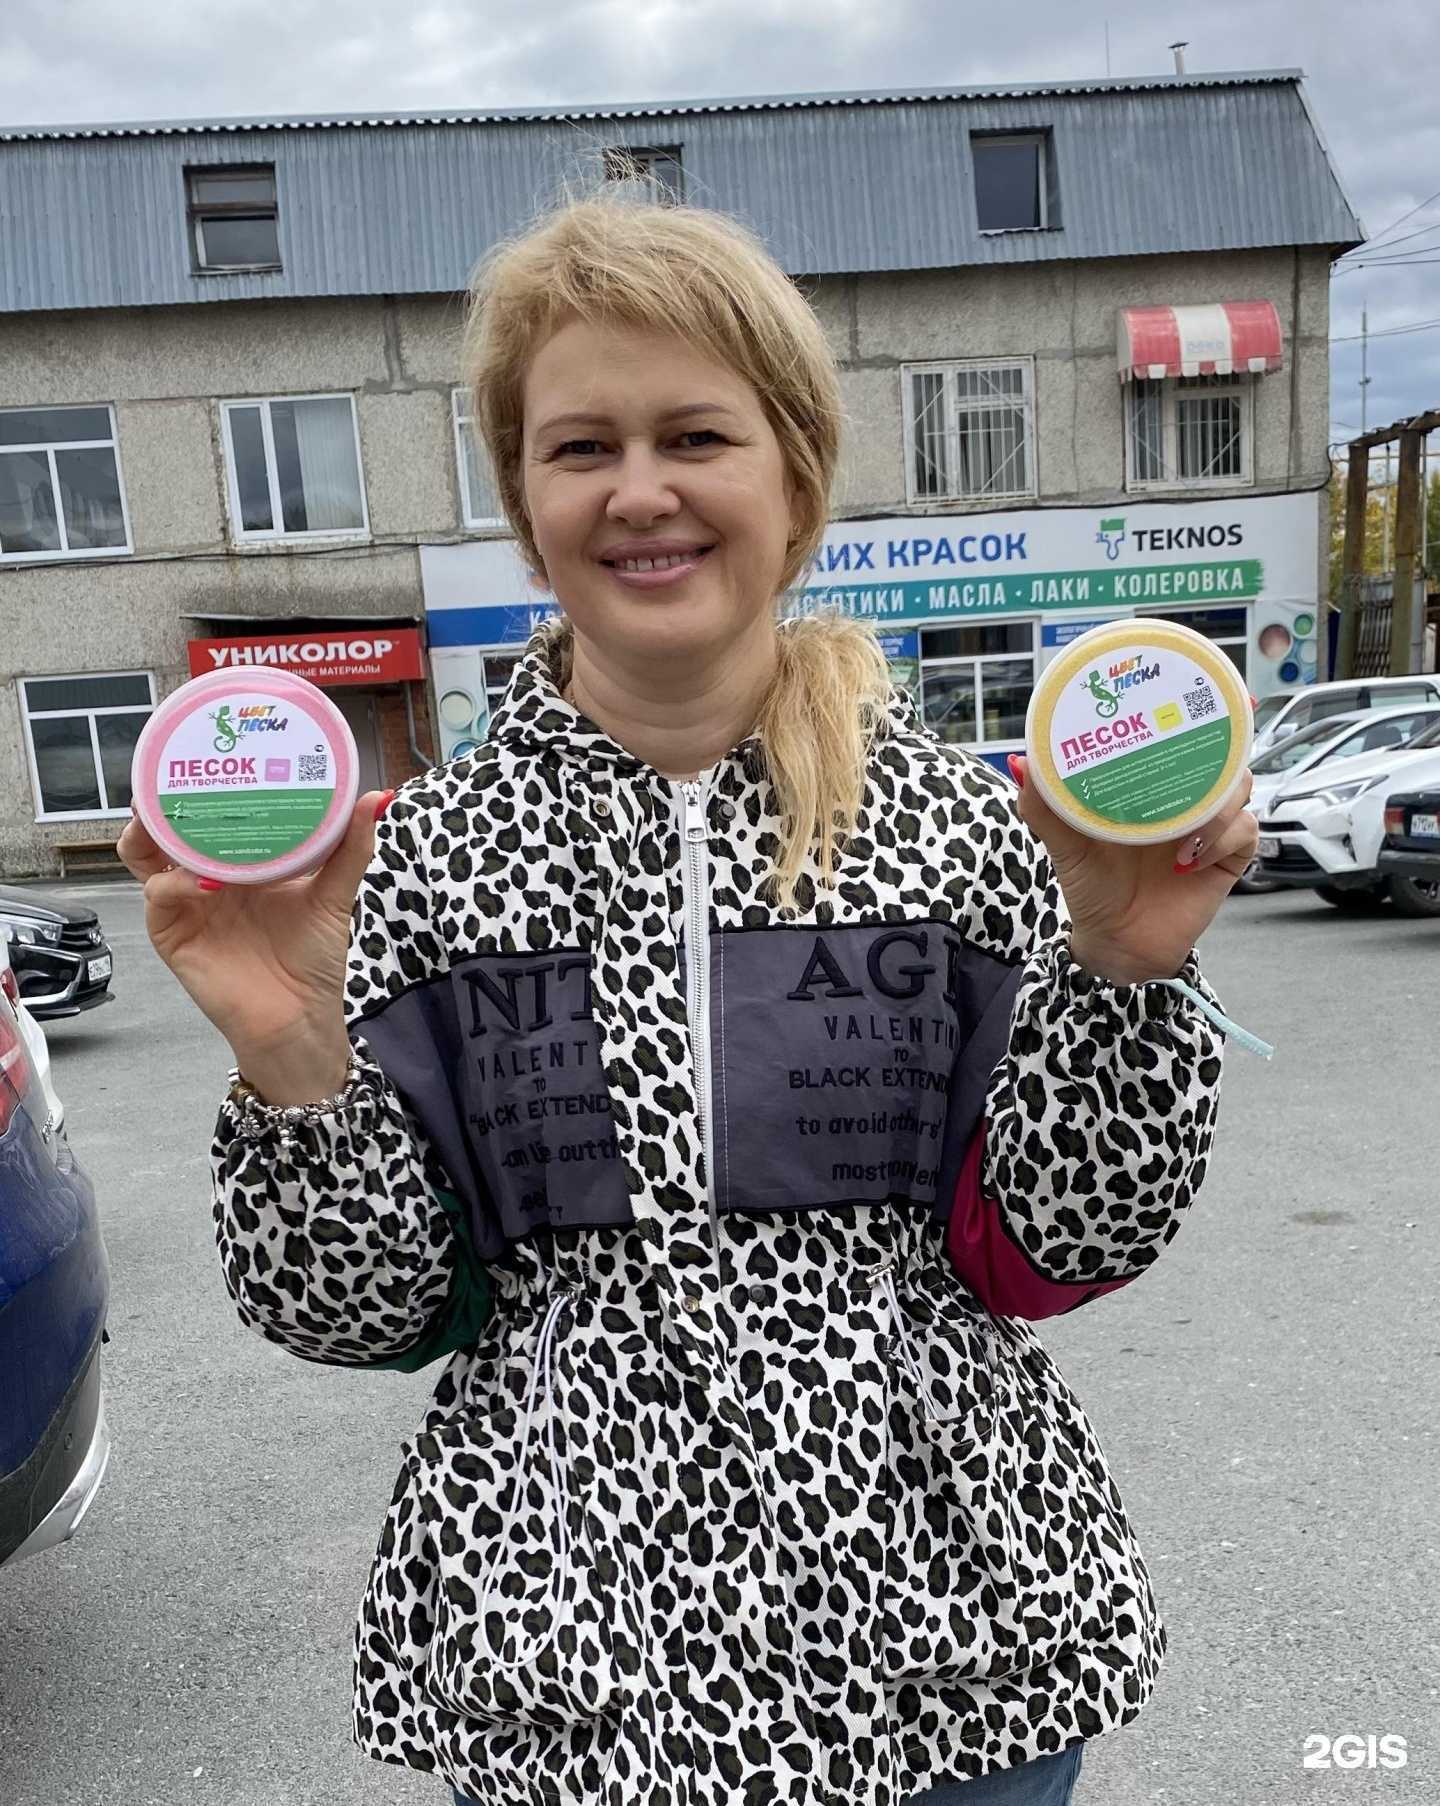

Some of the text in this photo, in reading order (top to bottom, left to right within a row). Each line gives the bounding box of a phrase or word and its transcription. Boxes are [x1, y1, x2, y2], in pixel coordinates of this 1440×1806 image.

[1132, 523, 1243, 551] TEKNOS
[887, 532, 1028, 568] КРАСОК
[928, 582, 1006, 609] МАСЛА
[1030, 577, 1090, 603] ЛАКИ
[1113, 567, 1244, 598] КОЛЕРОВКА
[207, 639, 393, 667] УНИКОЛОР
[319, 664, 381, 677] МАТЕРИАЛЫ
[1109, 655, 1143, 679] ЦВЕТ
[1113, 663, 1161, 692] ПЕСКА
[238, 705, 276, 718] ЦВЕТ
[237, 718, 288, 732] ПЕСКА
[1060, 712, 1148, 760] ПЕСОК
[1067, 730, 1154, 770] ДЛЯ ТВОРЧЕСТВА
[169, 757, 256, 778] ПЕСОК
[168, 776, 258, 788] ДЛЯ ТВОРЧЕСТВА
[893, 1048, 909, 1063] TO
[532, 1077, 547, 1093] TO
[789, 1067, 871, 1089] BLACK
[527, 1095, 613, 1120] EXTEND
[796, 1117, 820, 1135] to
[829, 1111, 886, 1135] avoid
[832, 1161, 887, 1182] most
